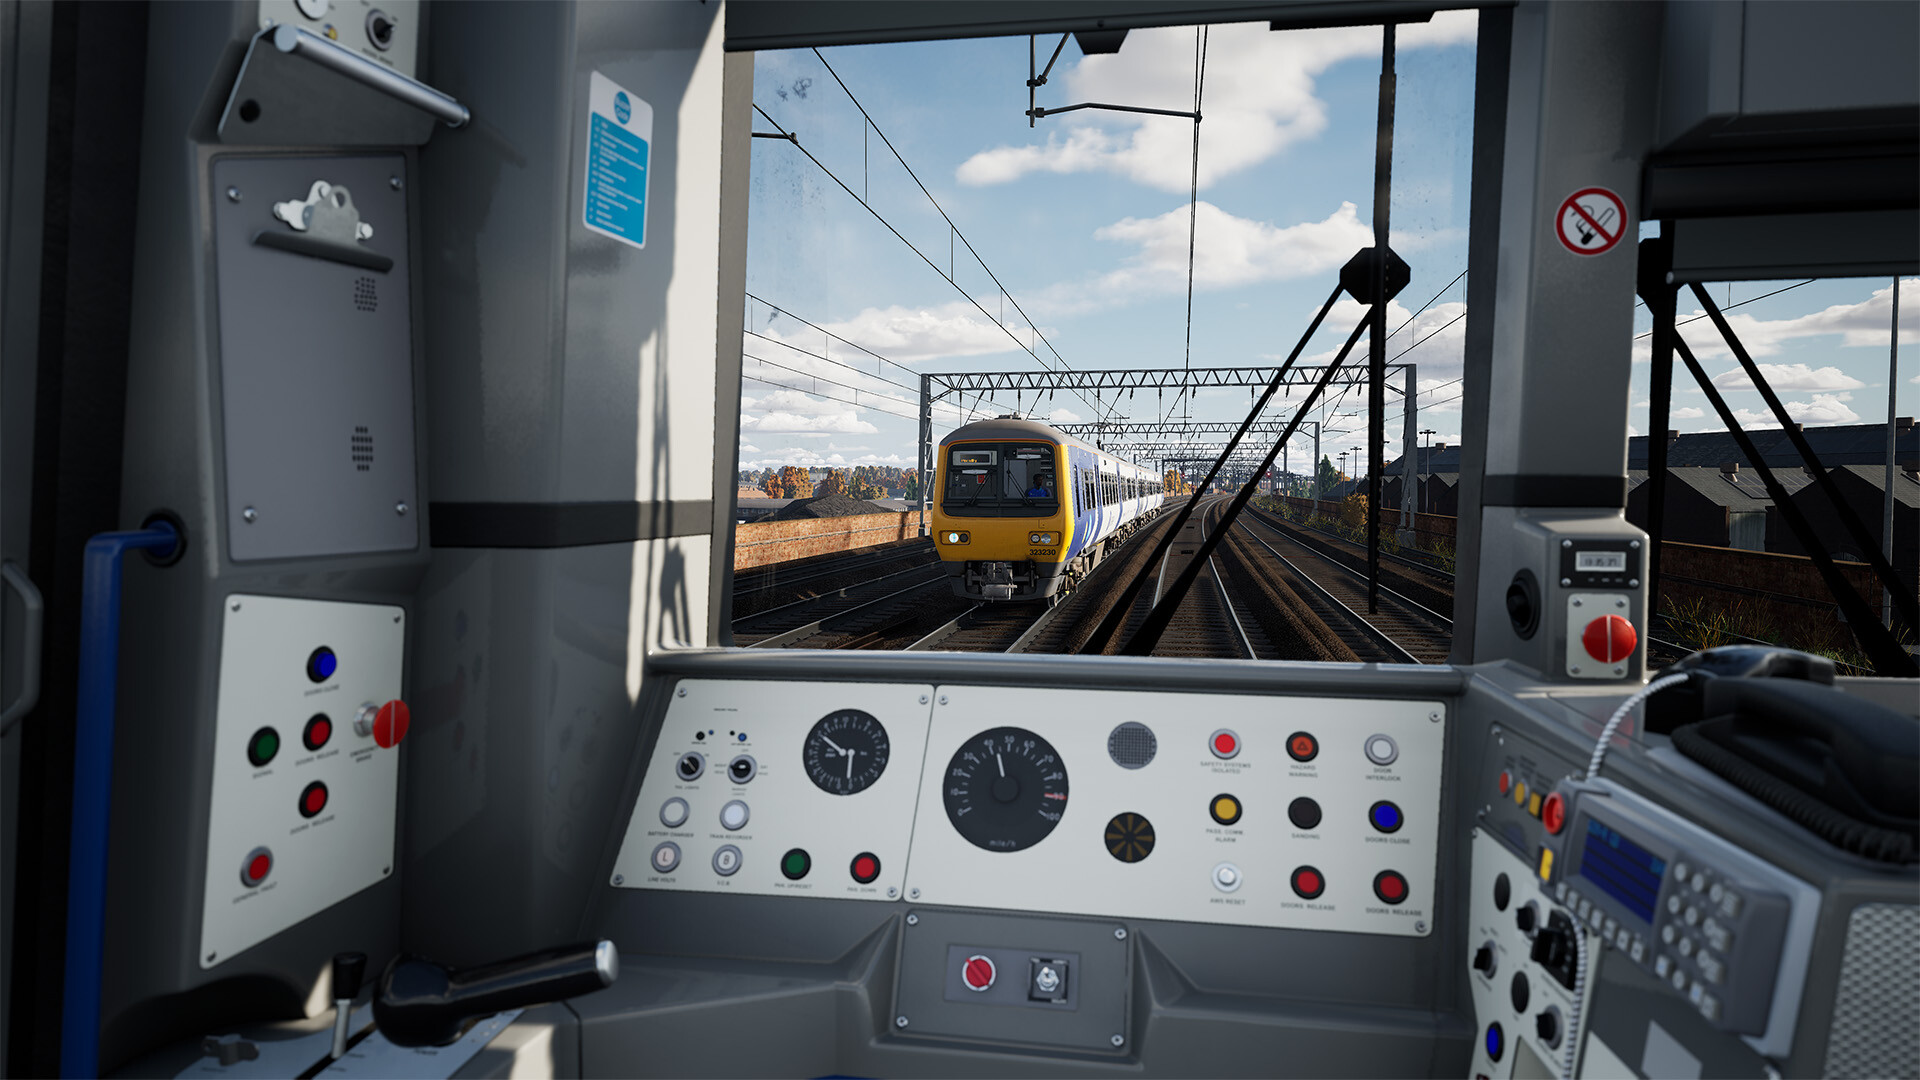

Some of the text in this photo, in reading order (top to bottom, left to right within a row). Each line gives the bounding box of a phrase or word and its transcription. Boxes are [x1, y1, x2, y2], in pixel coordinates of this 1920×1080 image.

[983, 739, 994, 747] 40
[1004, 735, 1015, 744] 50
[1023, 740, 1035, 749] 60
[963, 752, 974, 760] 30
[952, 768, 963, 777] 20
[950, 788, 959, 797] 10
[1046, 813, 1061, 821] 100
[647, 830, 669, 838] BATTERY
[989, 840, 1017, 848] mile/h
[1366, 907, 1390, 915] DOORS
